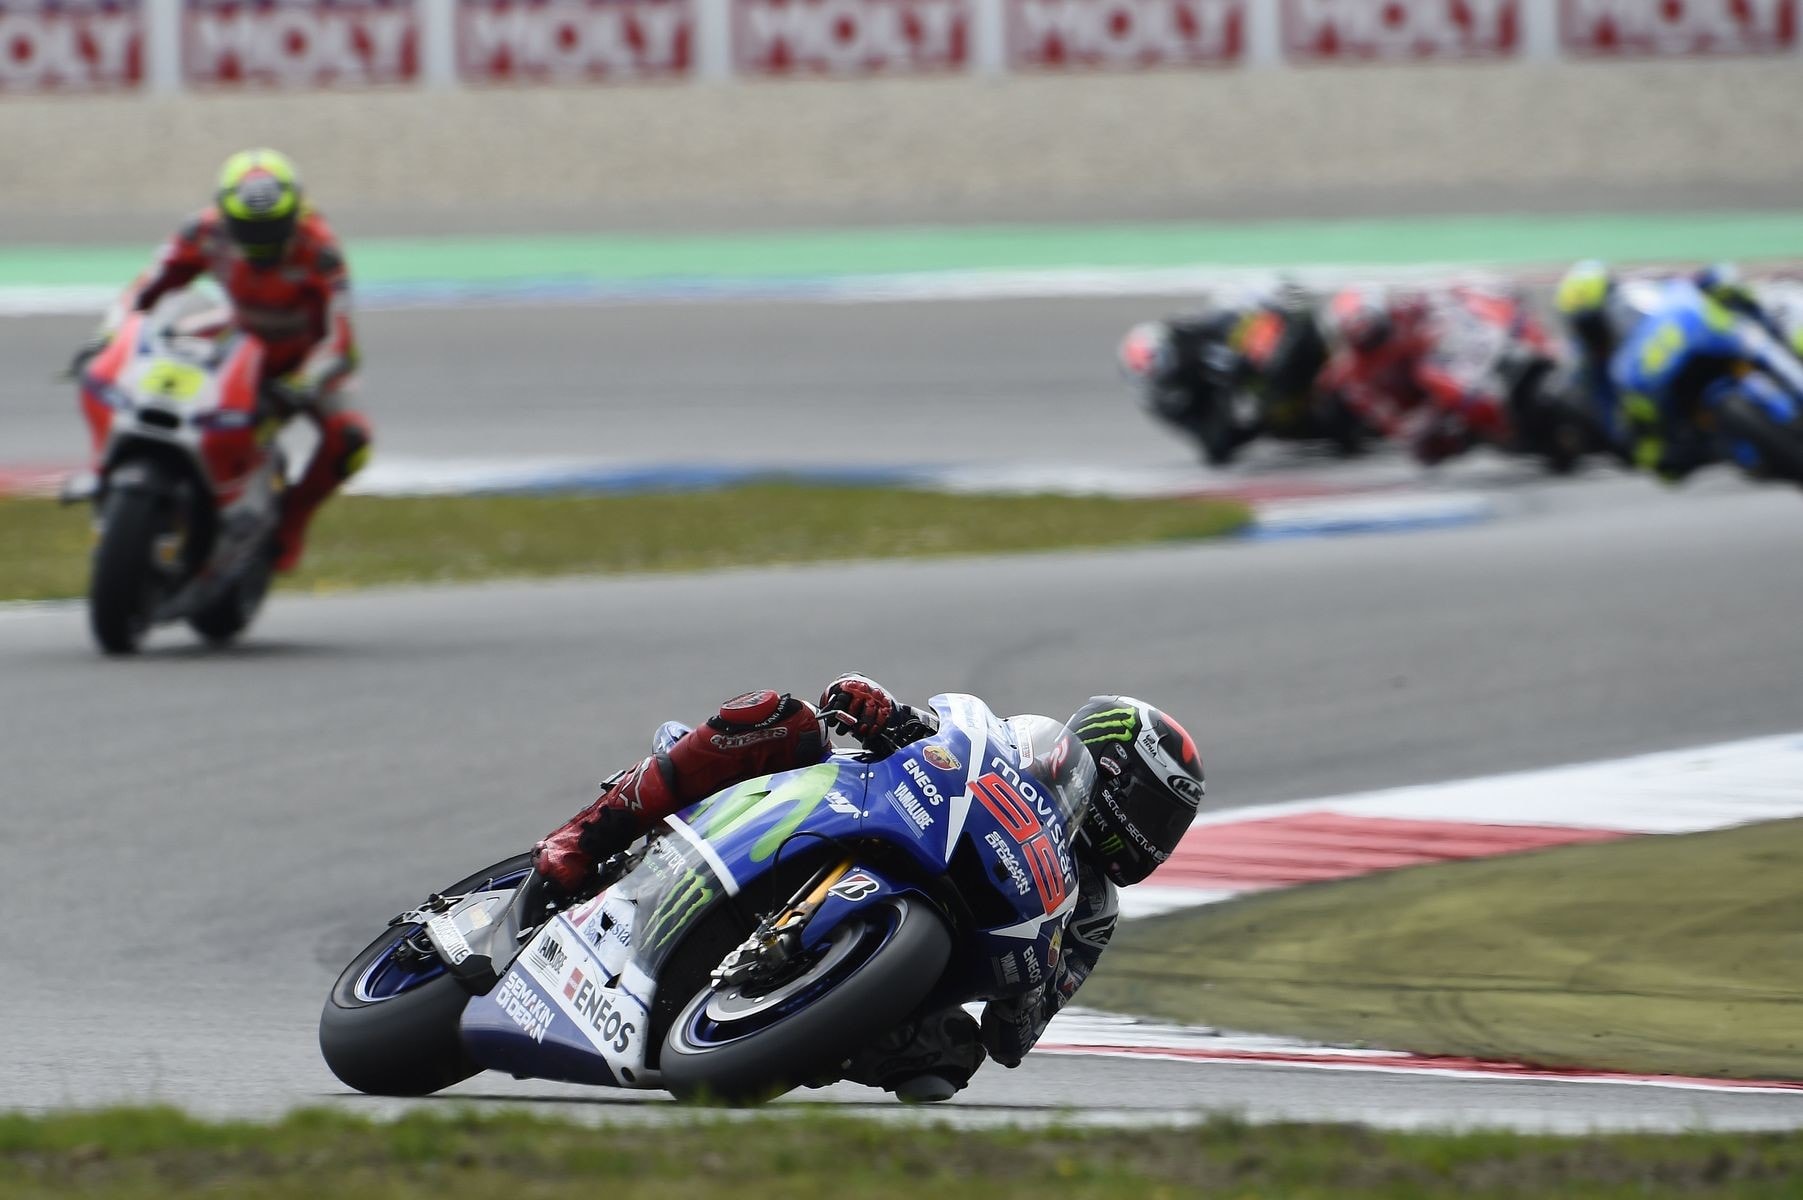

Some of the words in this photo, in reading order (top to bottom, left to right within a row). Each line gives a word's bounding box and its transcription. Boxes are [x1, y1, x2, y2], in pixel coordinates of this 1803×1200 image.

[192, 11, 416, 76] MOLY
[465, 4, 691, 69] MOLY
[740, 0, 966, 63] MOLY
[1015, 0, 1241, 56] MOLY
[893, 782, 934, 830] YAMALUBE
[902, 758, 943, 806] ENEOS
[1101, 789, 1127, 823] SECTOR
[1125, 823, 1156, 854] SECTOR
[1022, 945, 1043, 984] ENEOS
[504, 971, 555, 1029] SEMAKIN
[505, 996, 546, 1045] DEPAN
[573, 980, 635, 1053] ENEOS
